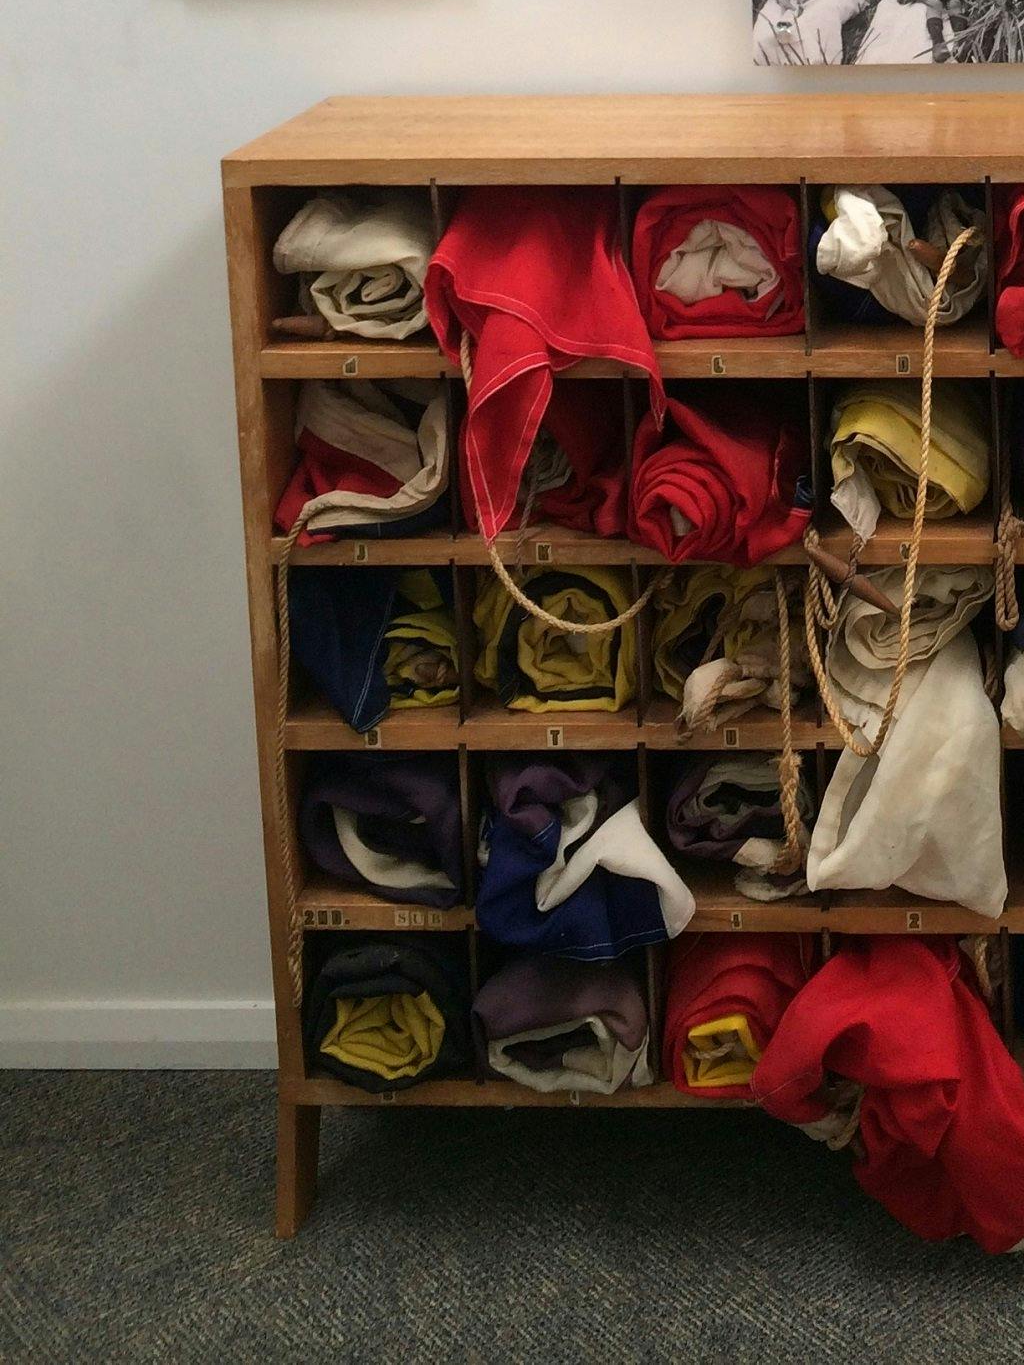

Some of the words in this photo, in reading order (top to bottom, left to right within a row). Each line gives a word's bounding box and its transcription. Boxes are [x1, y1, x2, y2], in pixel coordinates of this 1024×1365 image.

[549, 729, 560, 745] T
[726, 730, 737, 745] U
[909, 914, 920, 928] 2
